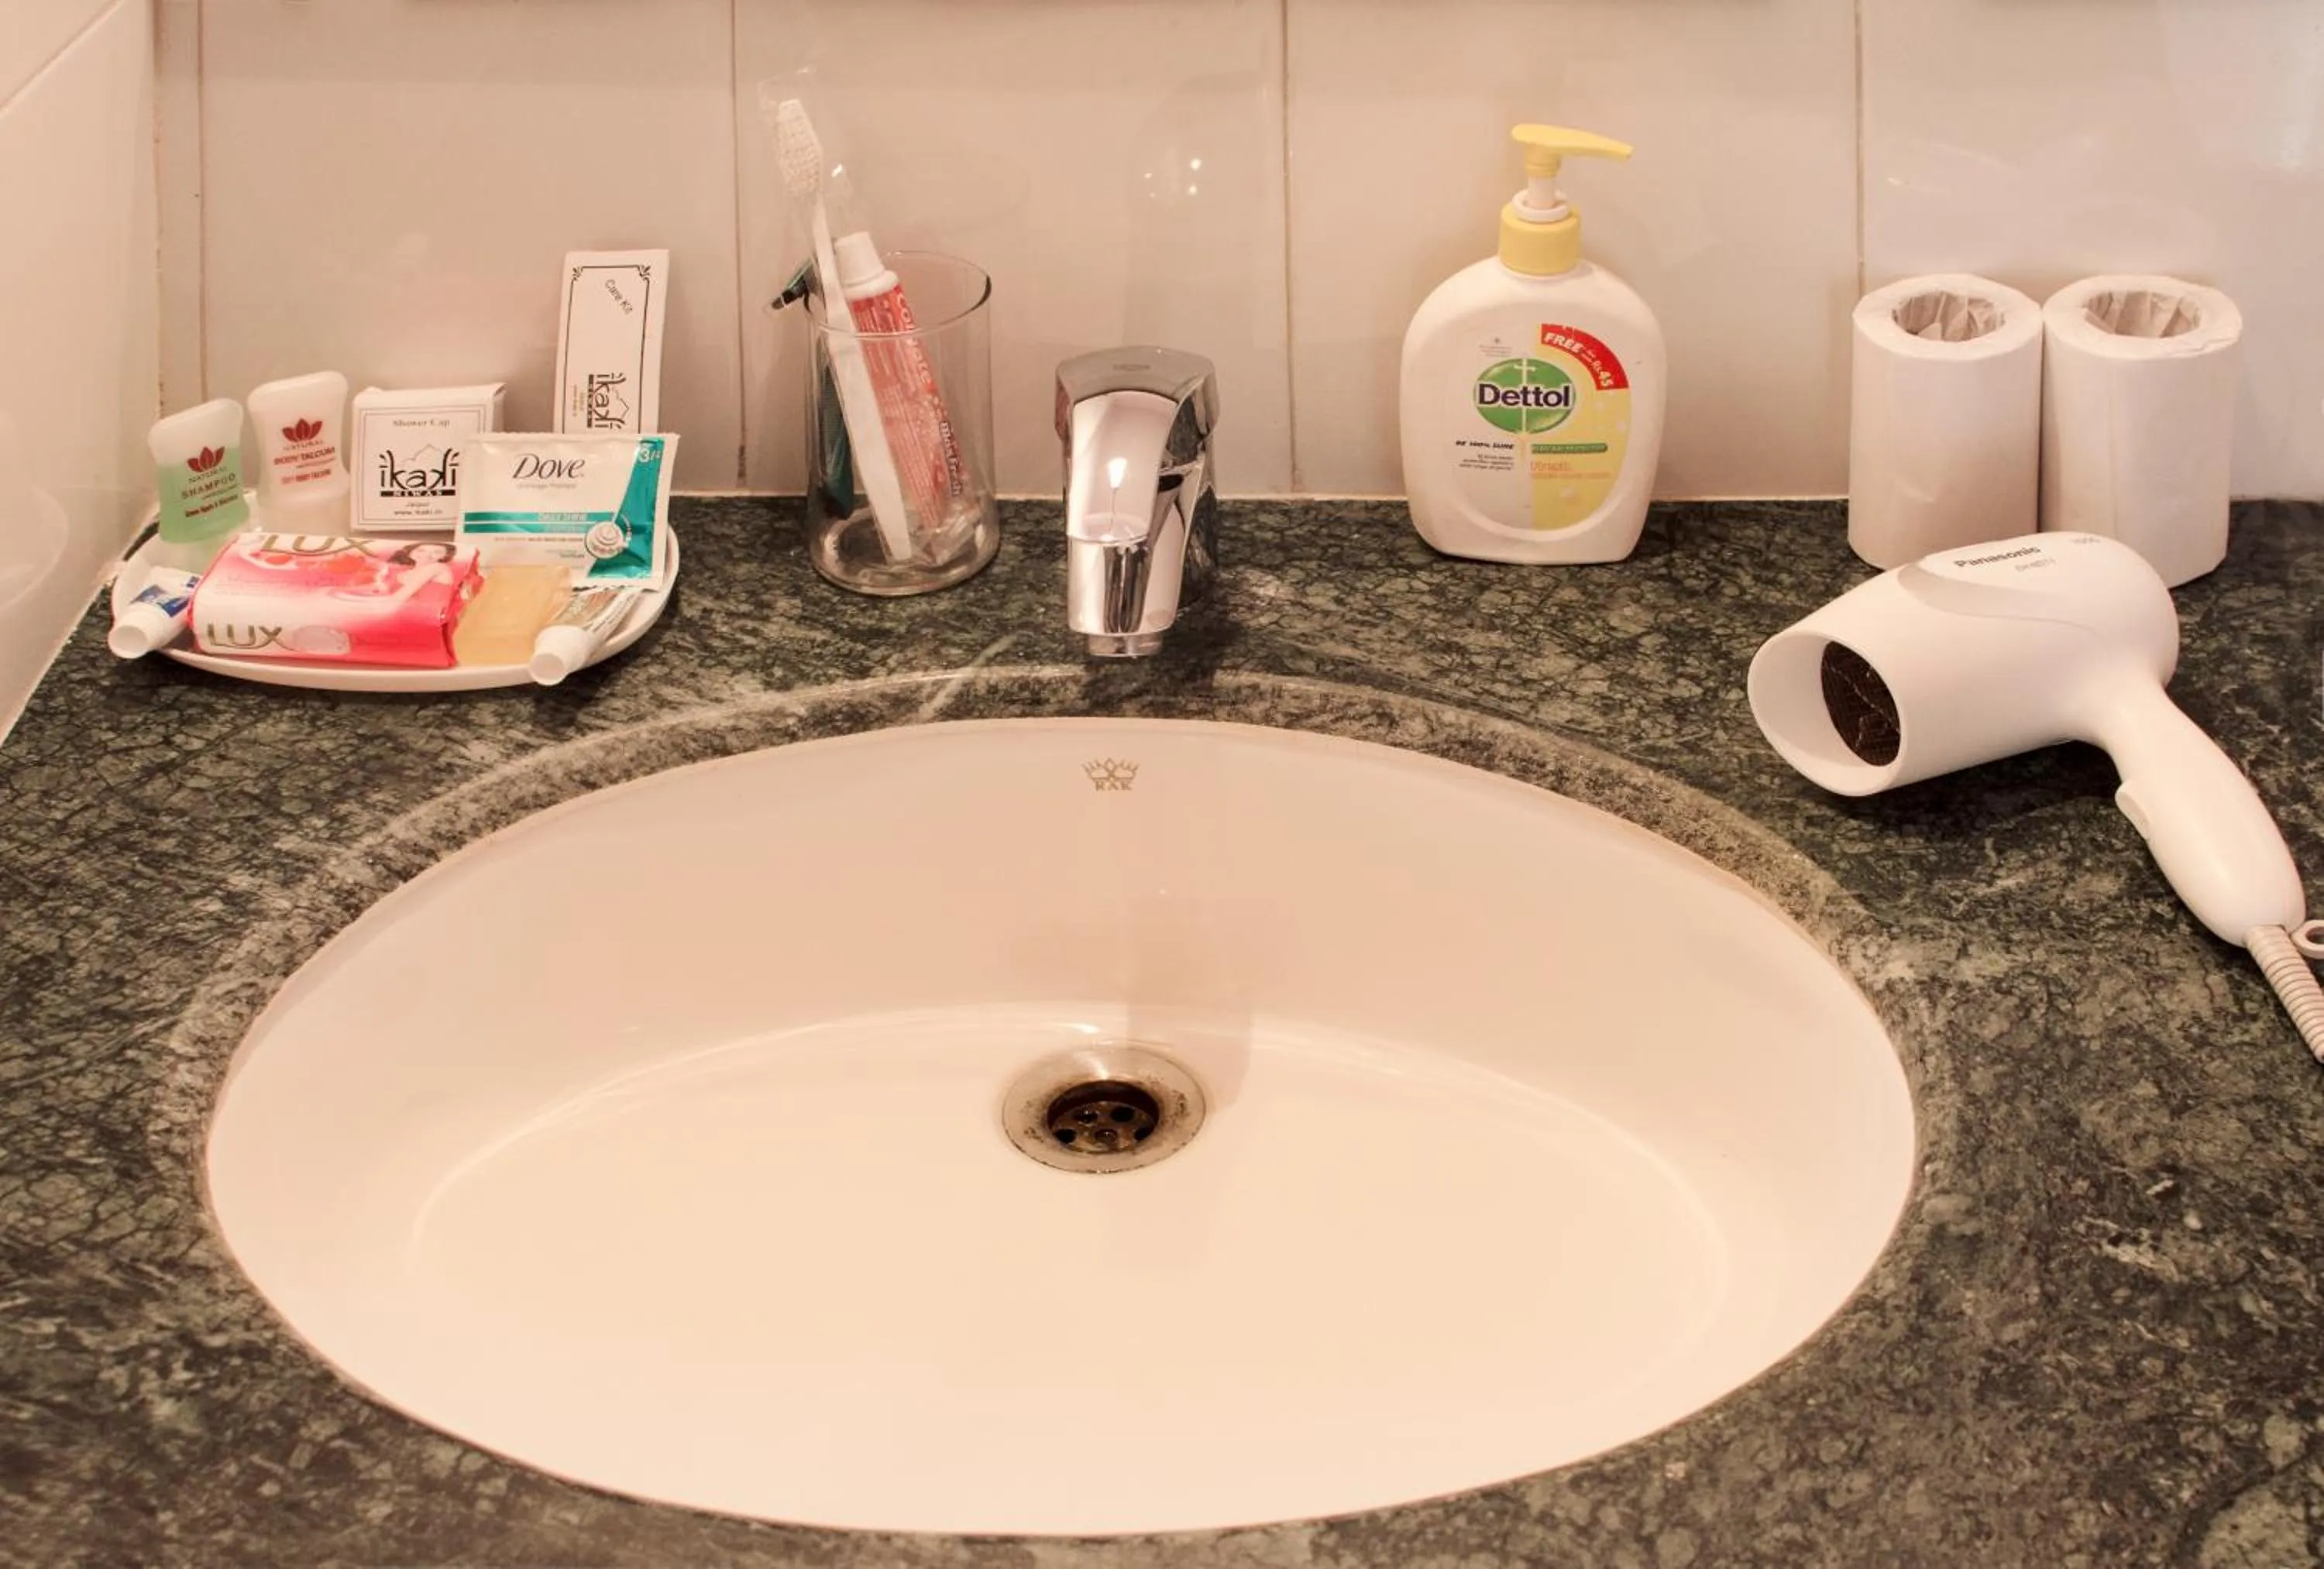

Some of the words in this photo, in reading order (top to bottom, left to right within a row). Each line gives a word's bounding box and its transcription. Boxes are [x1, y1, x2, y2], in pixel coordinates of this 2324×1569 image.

[1544, 332, 1583, 352] FREE
[1478, 383, 1571, 407] Dettol
[512, 453, 586, 479] Dove
[181, 472, 235, 500] SHAMPOO
[260, 534, 380, 558] LUX
[1954, 546, 2041, 568] Panasonic
[208, 624, 298, 651] LUX
